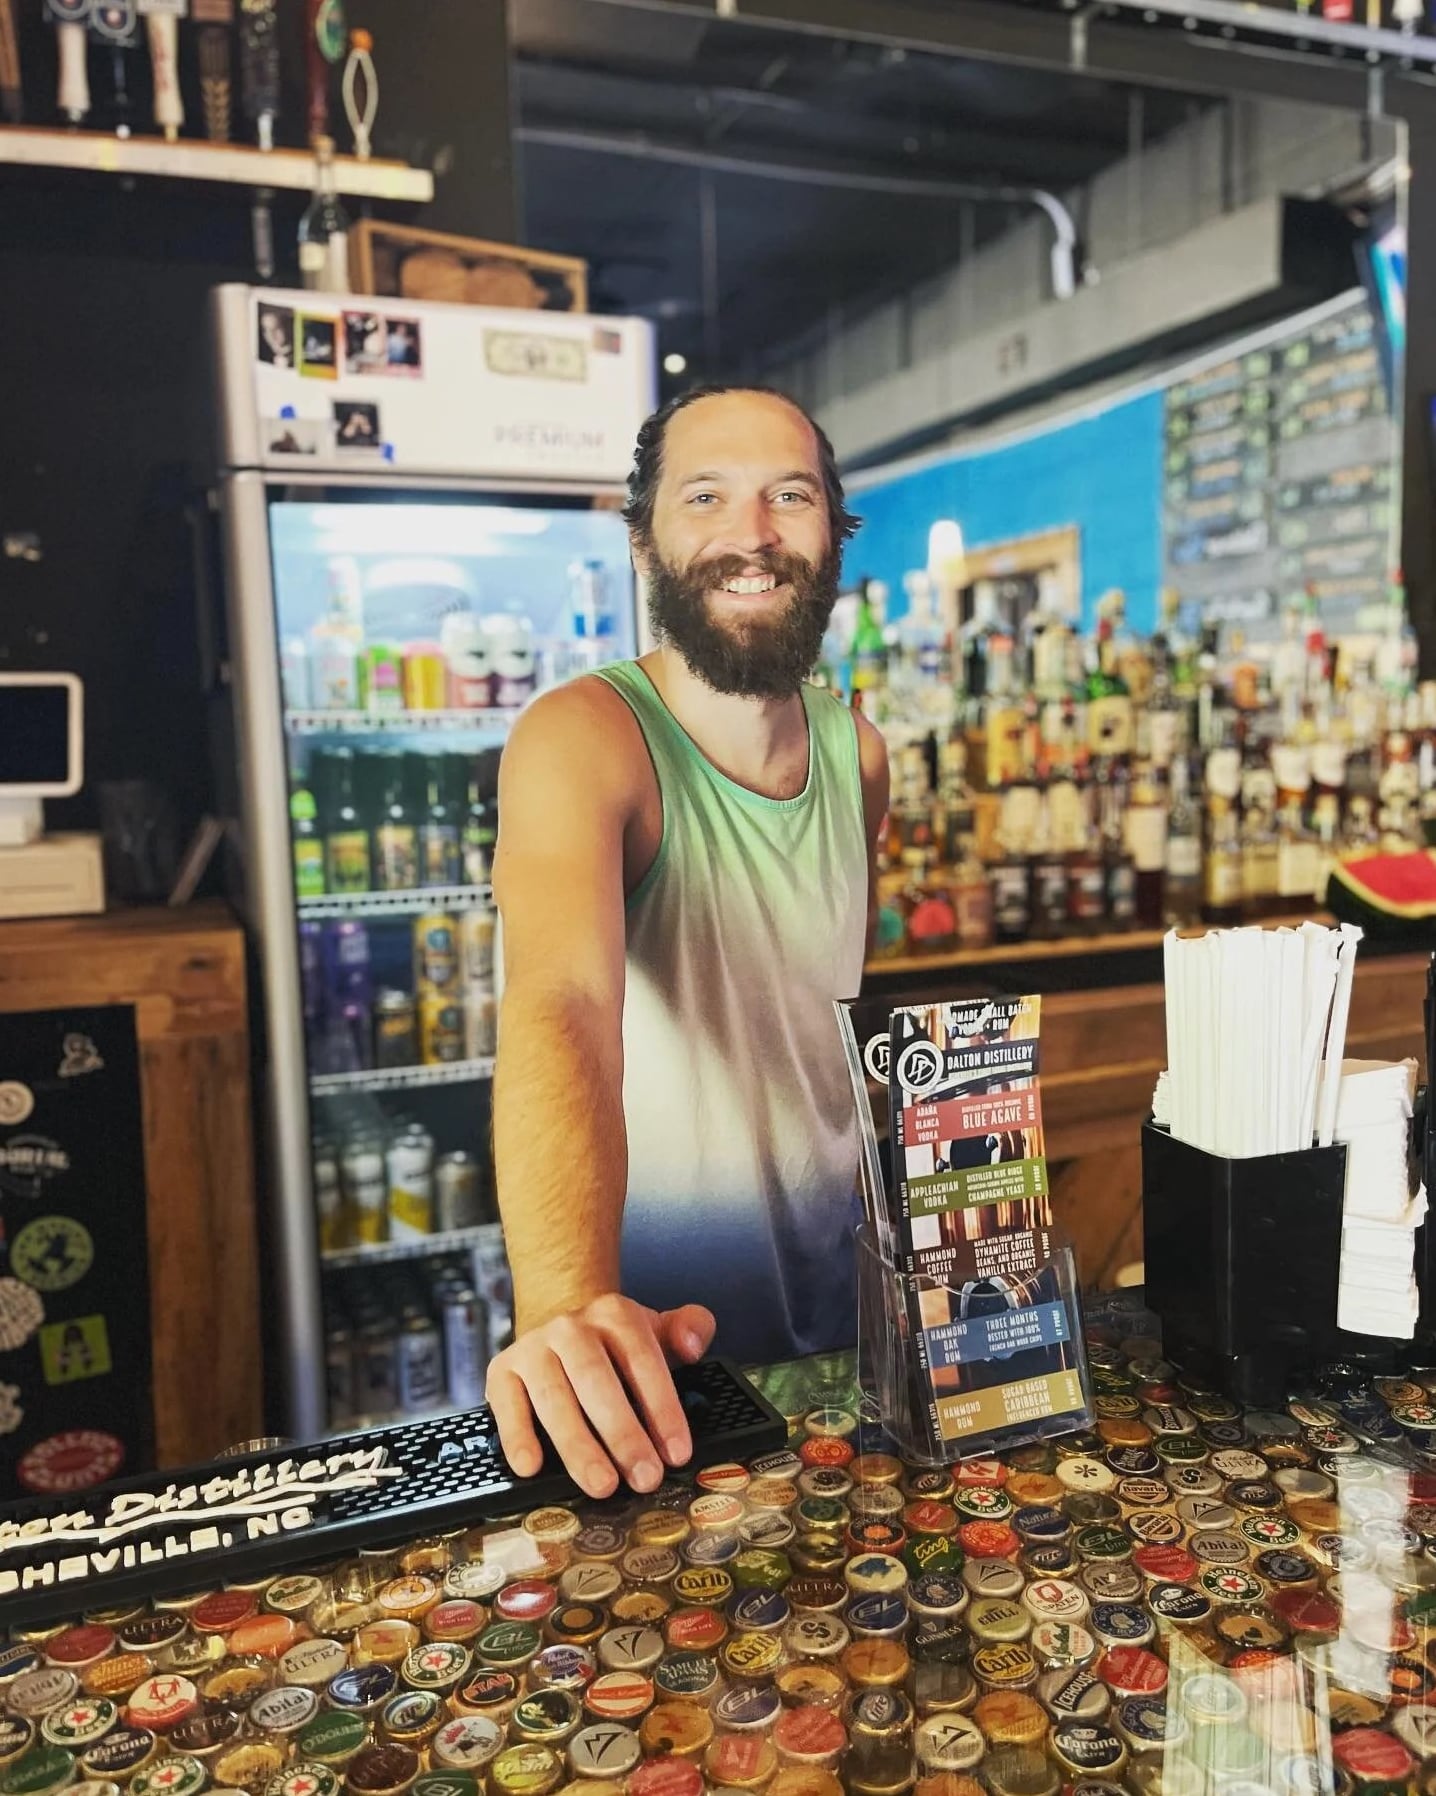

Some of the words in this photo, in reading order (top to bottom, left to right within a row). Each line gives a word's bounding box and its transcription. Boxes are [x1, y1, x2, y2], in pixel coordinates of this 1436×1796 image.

[992, 1018, 1010, 1031] RUM
[947, 1052, 981, 1070] DALTON
[984, 1045, 1033, 1065] DISTILLERY
[962, 1111, 987, 1129] BLUE
[990, 1106, 1022, 1125] AGAVE
[917, 1130, 938, 1142] VODKA
[966, 1171, 993, 1183] DISTILLED
[910, 1181, 959, 1199] APPLEACHIAN
[968, 1187, 1005, 1203] CHAMPAGNE
[1006, 1183, 1025, 1196] YEAST
[923, 1194, 948, 1209] VODKA
[1014, 1230, 1033, 1241] ORGANIC
[920, 1247, 957, 1264] HAMMOND
[974, 1242, 1009, 1259] DYNAMITE
[1010, 1237, 1035, 1252] COFFEE
[997, 1253, 1010, 1264] AND
[1010, 1248, 1036, 1261] ORGANIC
[927, 1260, 953, 1276] COFFEE
[977, 1263, 1006, 1279] VANILLA
[1007, 1257, 1036, 1273] EXTRACT
[985, 1316, 1008, 1332] THREE
[1009, 1310, 1039, 1327] MONTHS
[929, 1323, 968, 1342] HAMMOND
[1008, 1326, 1025, 1338] WITH
[943, 1339, 959, 1352] OAK
[944, 1351, 961, 1364] RUM
[1001, 1384, 1024, 1400] SUGAR
[1025, 1378, 1048, 1394] BASED
[942, 1400, 981, 1419] HAMMOND
[1004, 1390, 1051, 1413] CARIBBEAN
[956, 1416, 974, 1430] RUM
[754, 1452, 800, 1473] ICEHOUSE
[1215, 1457, 1266, 1469] ULTRA
[1123, 1485, 1166, 1494] Bavaria
[1141, 1514, 1169, 1537] Bavaria
[1245, 1515, 1287, 1535] Heineken
[1198, 1536, 1243, 1551] Abita!
[1269, 1531, 1298, 1545] Beer
[914, 1536, 949, 1560] ting
[676, 1573, 728, 1590] Carib
[1207, 1567, 1259, 1590] Heineken
[1042, 1593, 1080, 1610] SPATEN
[1153, 1592, 1204, 1612] Corona
[1209, 1585, 1243, 1601] Beer
[123, 1614, 184, 1635] ULTRA
[915, 1625, 962, 1645] GUINNESS
[286, 1648, 346, 1673] ULTRA
[438, 1656, 467, 1679] Beer
[978, 1647, 1031, 1674] Carib
[1053, 1671, 1097, 1711] ICEHOUSE
[172, 1716, 238, 1741] ULTRA
[83, 1734, 150, 1762] Corona
[1054, 1733, 1118, 1751] Corona
